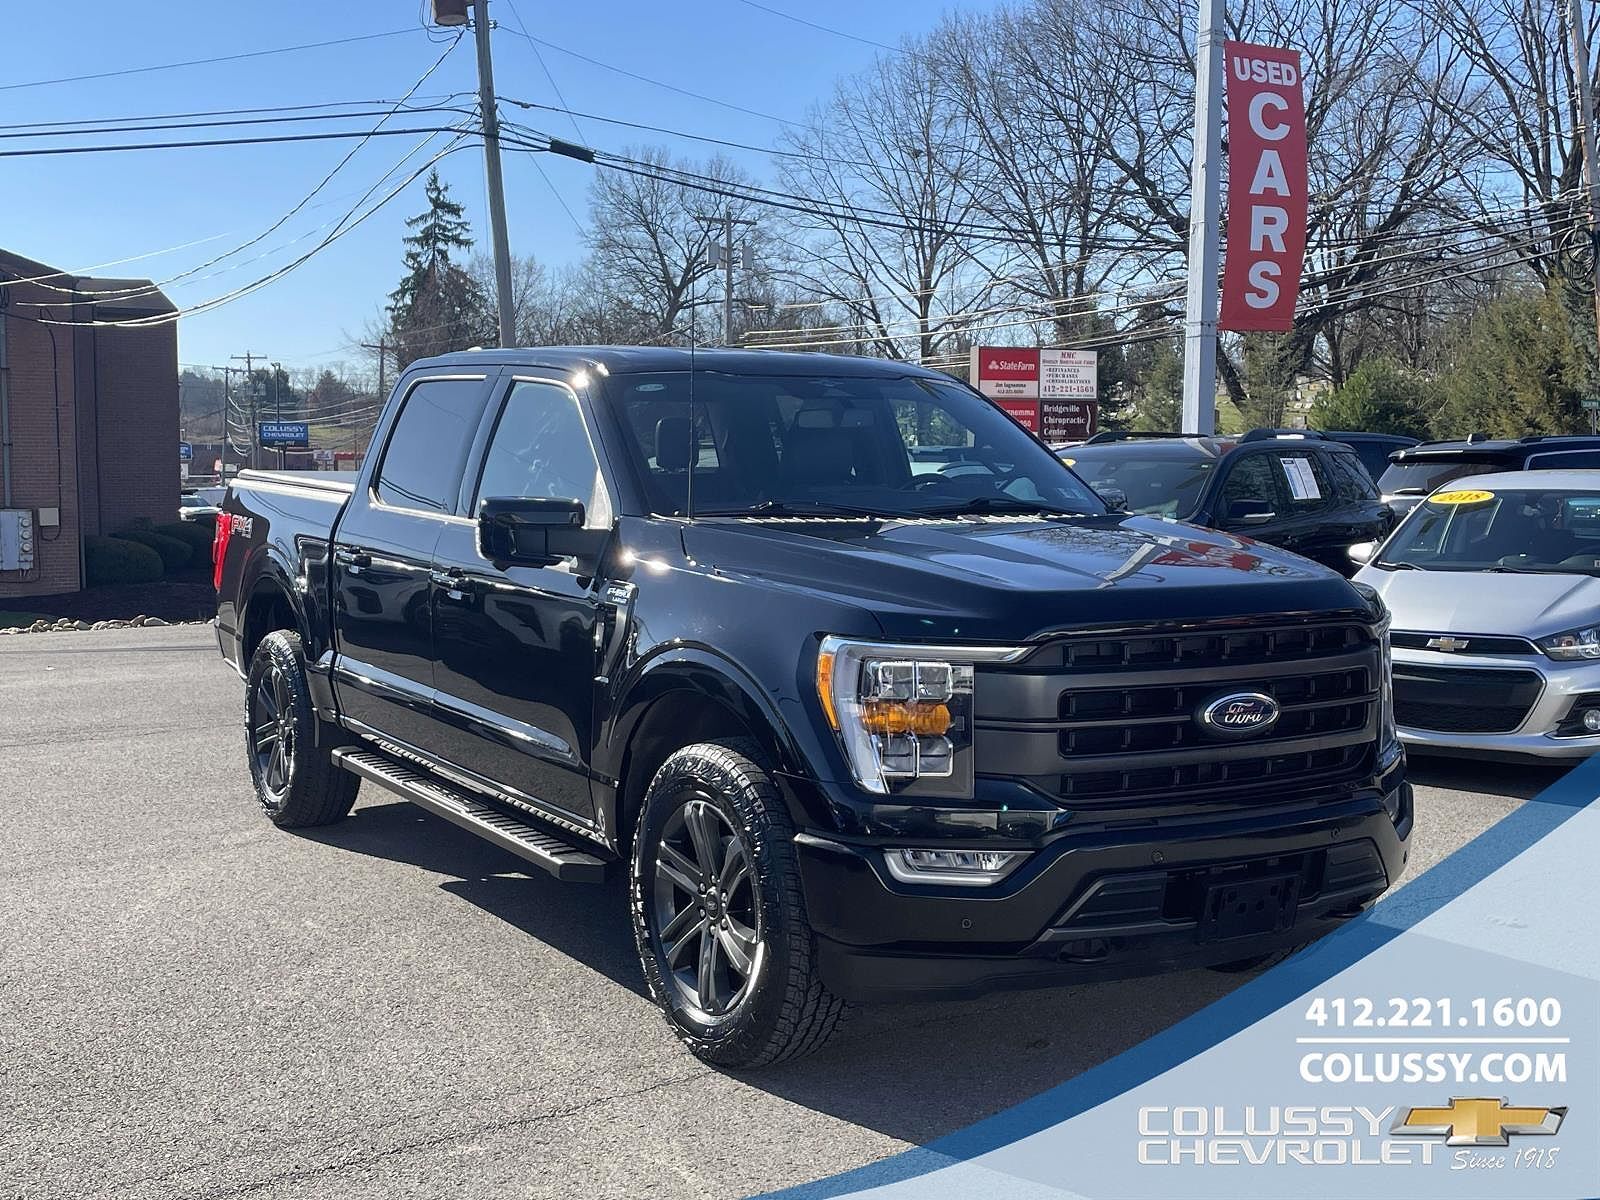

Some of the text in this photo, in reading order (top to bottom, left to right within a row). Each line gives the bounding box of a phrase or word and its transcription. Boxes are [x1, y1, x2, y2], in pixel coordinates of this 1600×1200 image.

[1233, 56, 1297, 86] USED
[1245, 91, 1291, 309] CARS
[1043, 404, 1080, 413] Bridgeville
[1043, 416, 1086, 425] Chiropractic
[1043, 428, 1067, 436] Center
[1224, 702, 1265, 724] Ford
